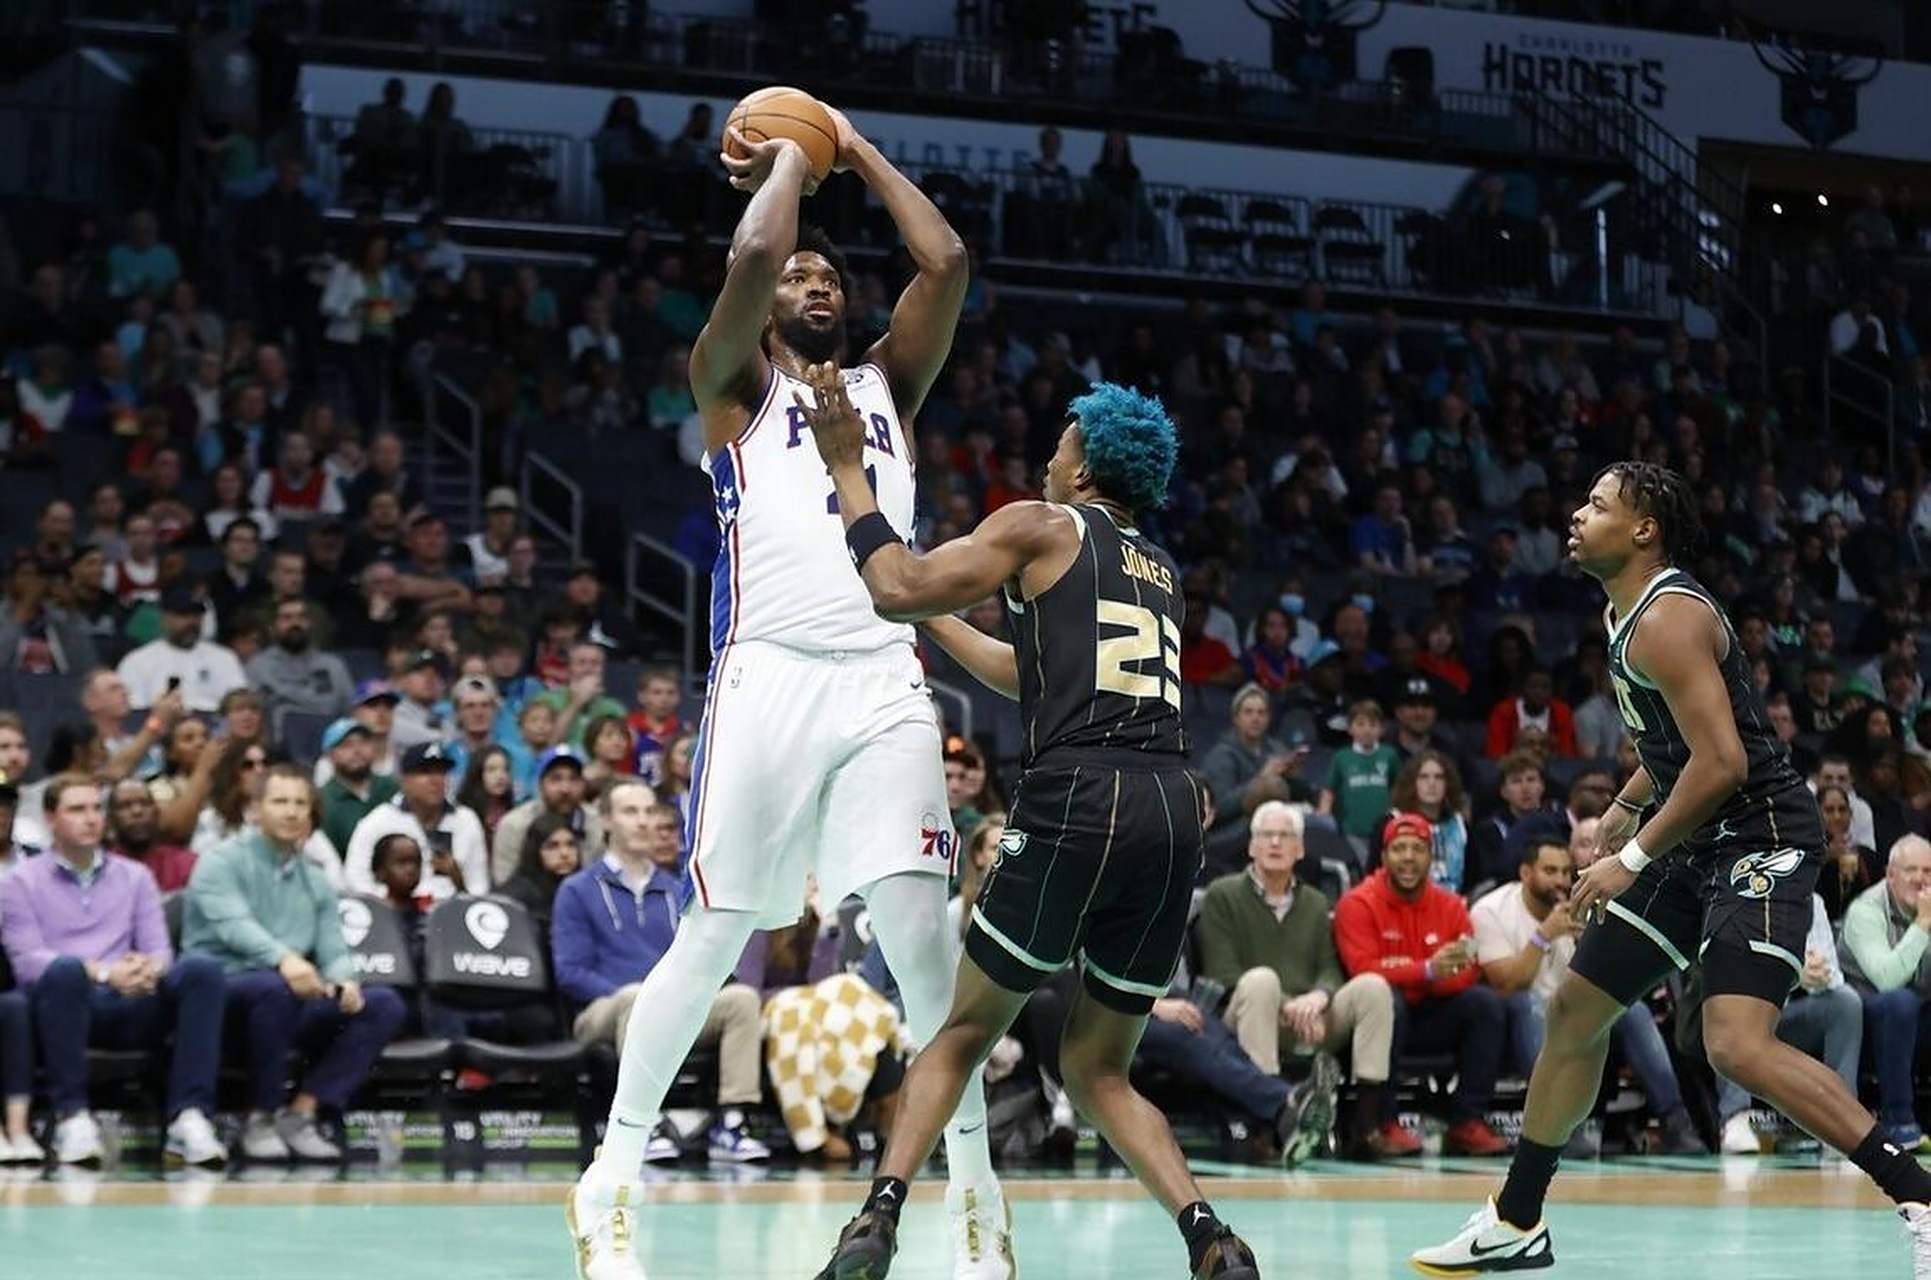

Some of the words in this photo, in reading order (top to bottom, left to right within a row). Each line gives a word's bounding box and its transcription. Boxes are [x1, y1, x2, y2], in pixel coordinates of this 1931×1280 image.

[1483, 42, 1667, 108] HORNETS
[1120, 542, 1174, 596] JONES
[920, 828, 951, 860] 76
